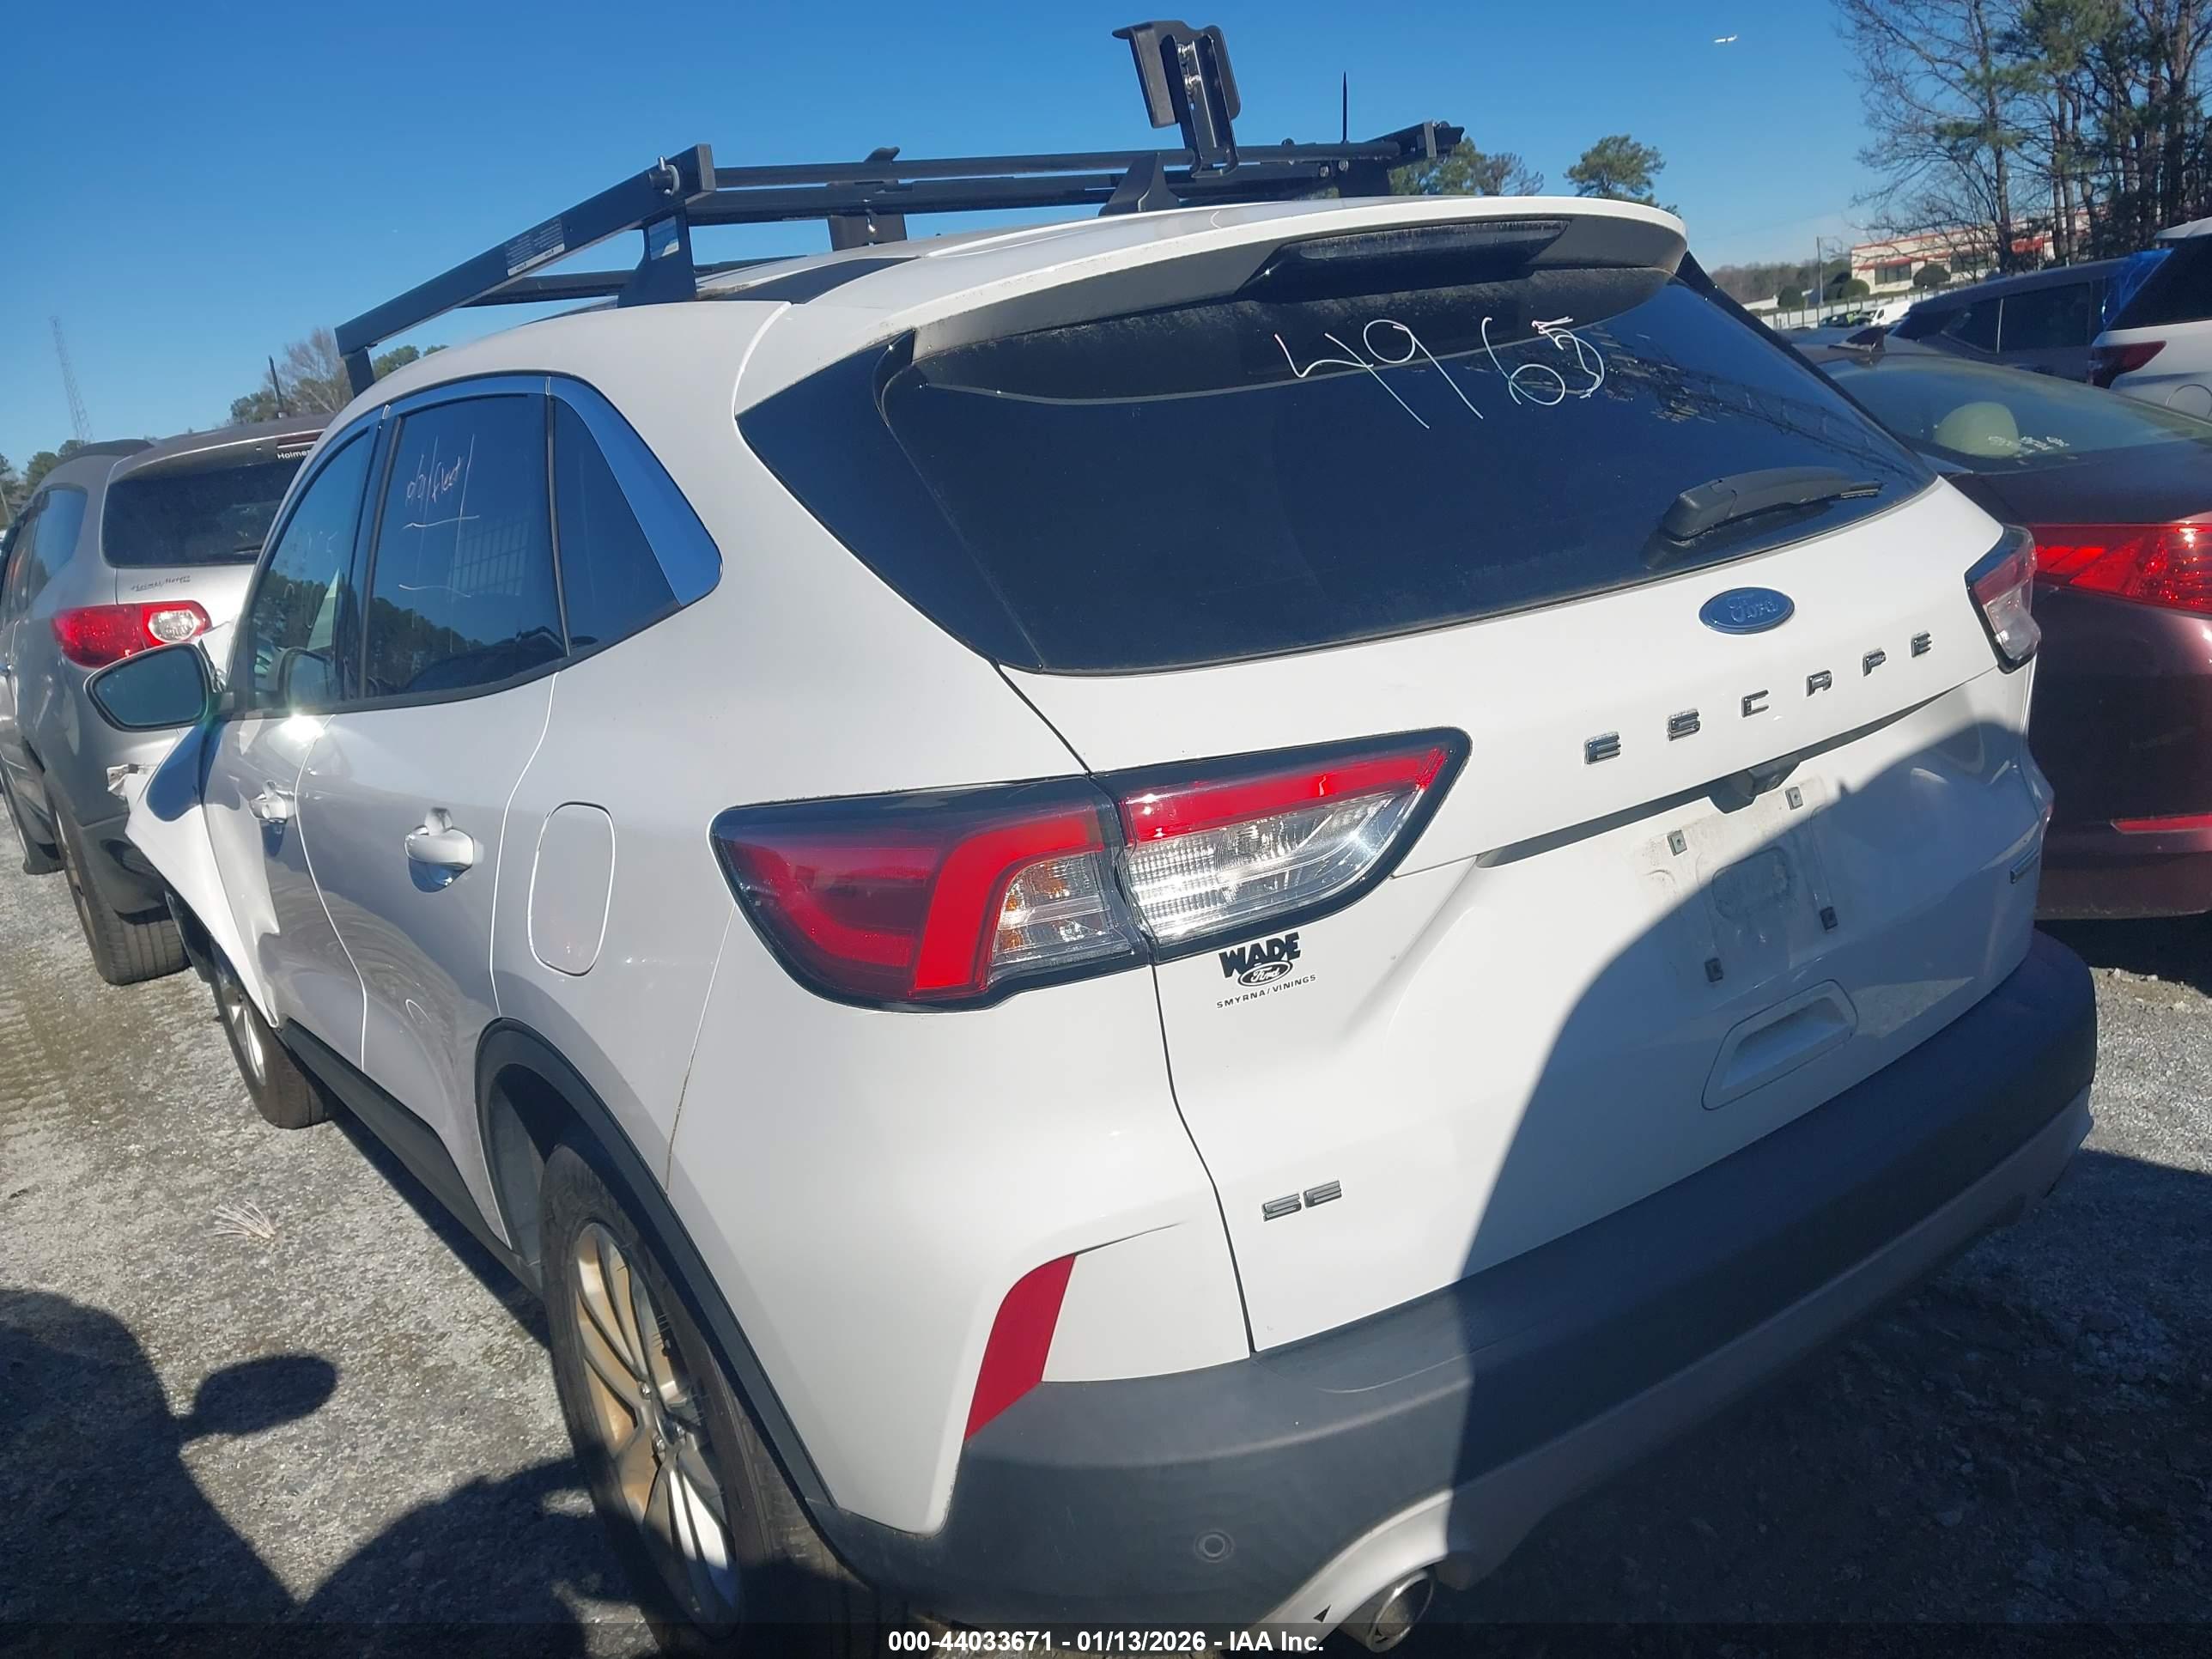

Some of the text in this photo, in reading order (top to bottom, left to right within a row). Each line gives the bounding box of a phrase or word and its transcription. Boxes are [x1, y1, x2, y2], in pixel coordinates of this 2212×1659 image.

[1726, 593, 1779, 623] Ford
[1583, 631, 1932, 765] ESCAPE
[1218, 932, 1301, 978] WADE
[1249, 966, 1282, 983] Ford
[1261, 1180, 1342, 1222] SE
